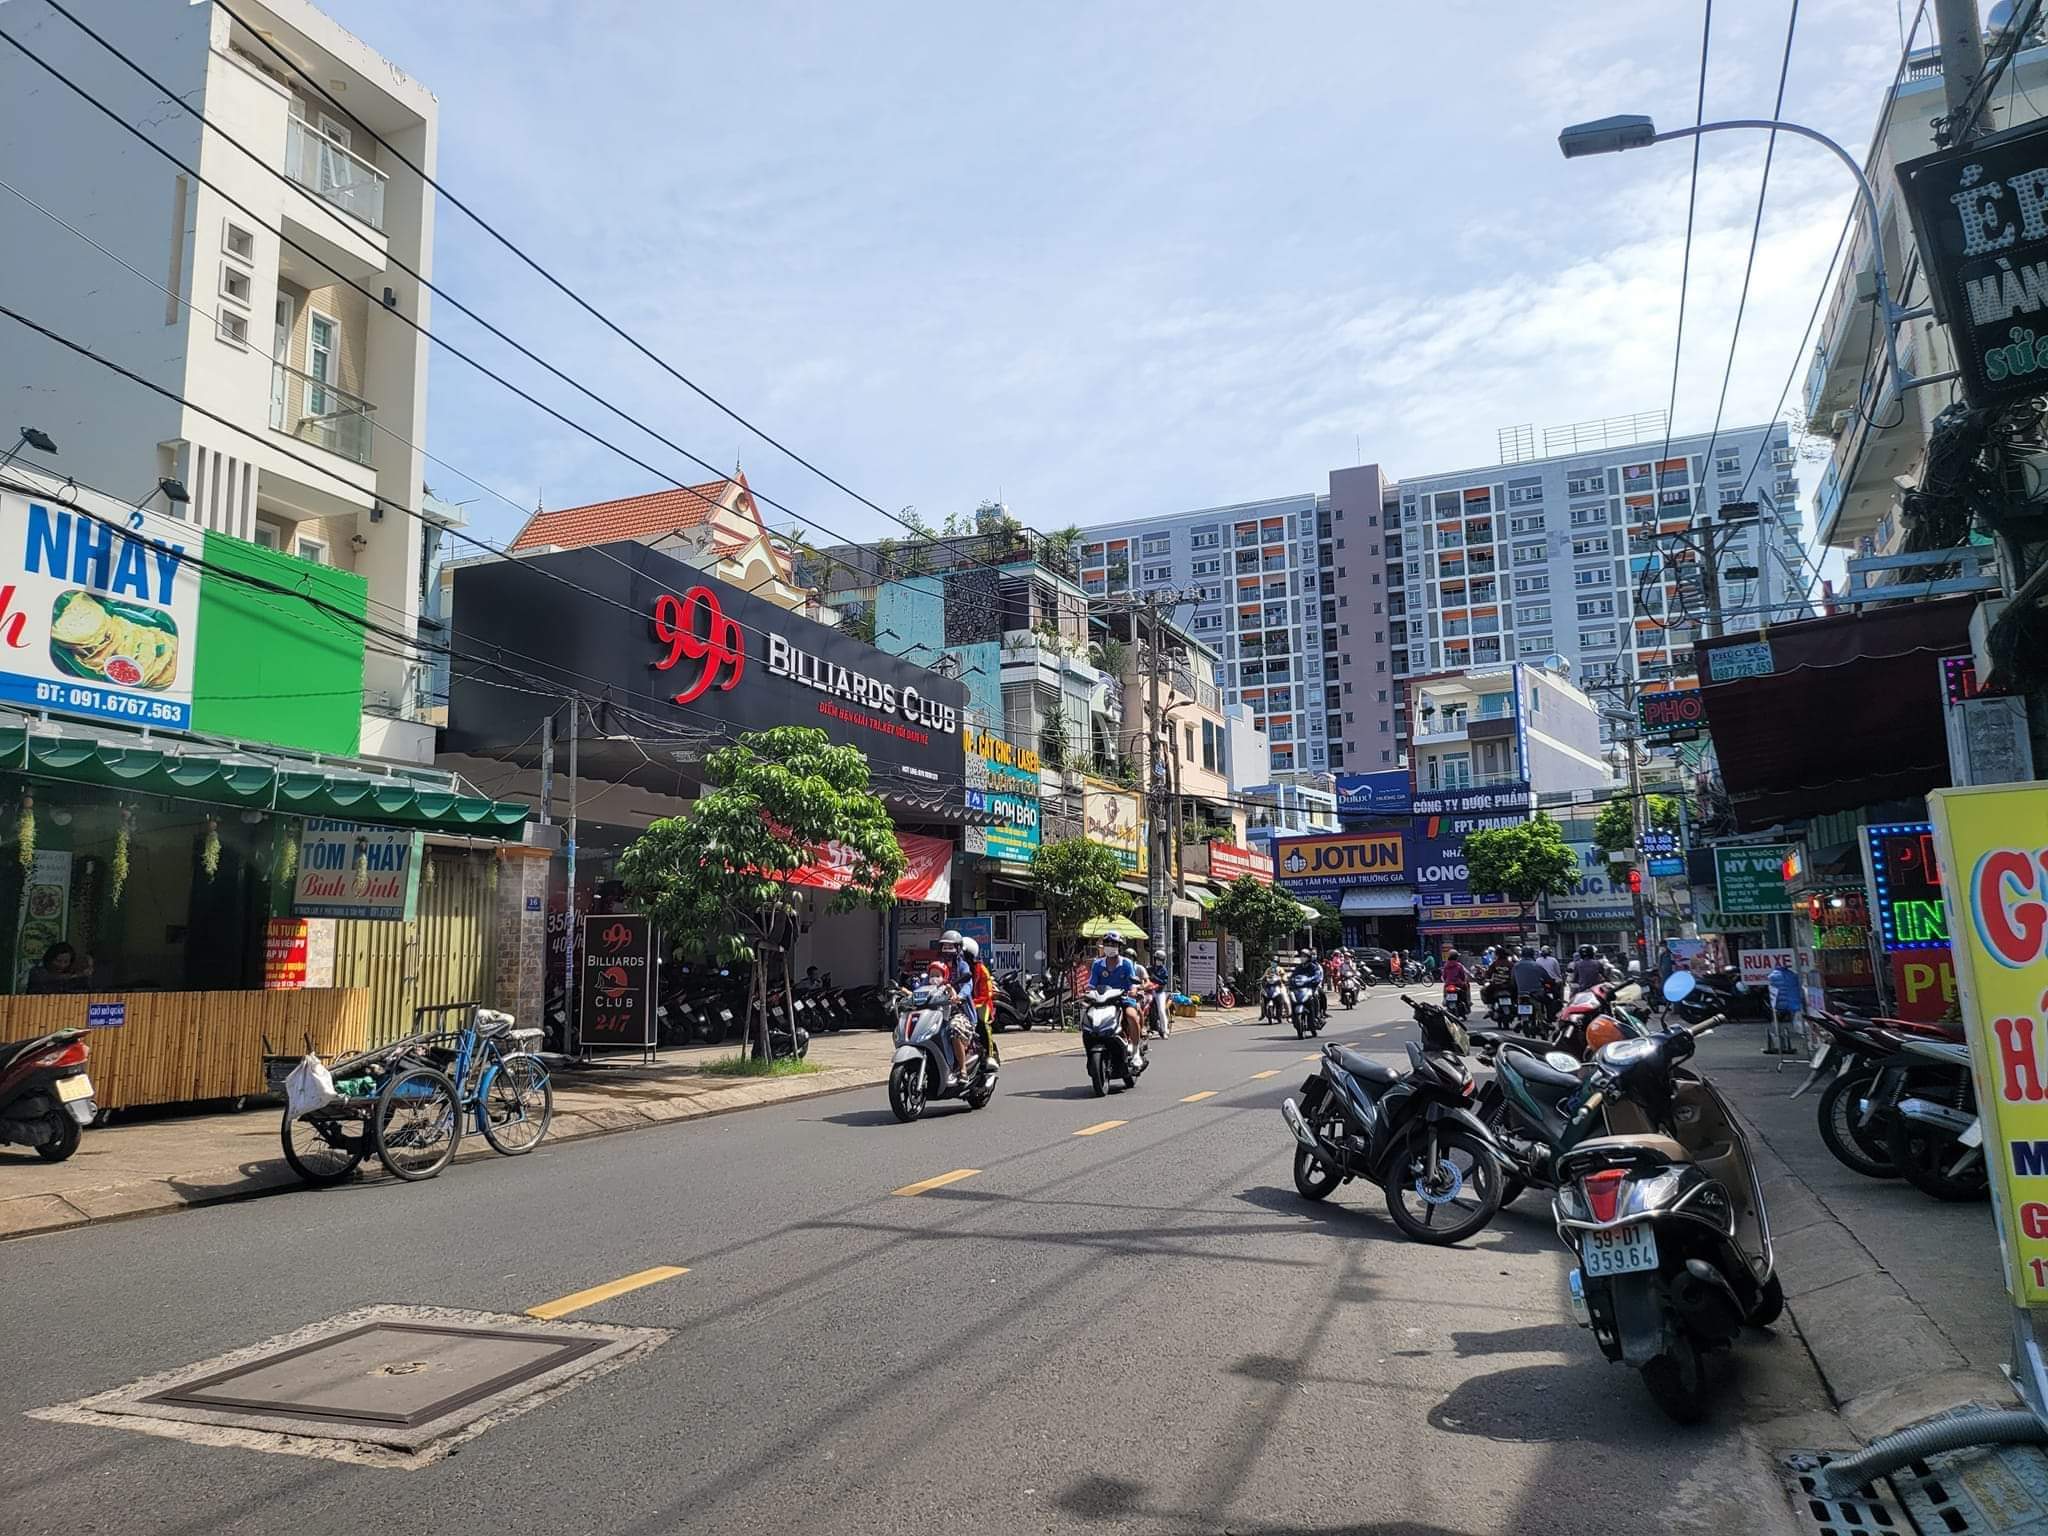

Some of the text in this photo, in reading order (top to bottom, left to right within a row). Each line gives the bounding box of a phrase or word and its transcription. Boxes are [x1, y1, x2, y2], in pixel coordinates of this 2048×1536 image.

[25, 503, 185, 606] NHẢY
[655, 585, 744, 704] 999
[768, 631, 956, 734] BILLIARDS CLUB
[37, 682, 182, 722] ĐT: 091.6767.563
[1413, 788, 1529, 813] CÔNG TY DƯỢC PHẨM
[1455, 819, 1474, 832] FPT
[303, 837, 346, 870] TÔM
[1312, 842, 1398, 871] JOTUN
[1724, 859, 1748, 873] HY
[1390, 873, 1404, 882] GIA
[1417, 865, 1470, 882] LONG
[1554, 909, 1578, 919] 370
[1972, 848, 2048, 967] G
[602, 923, 632, 952] 999
[588, 954, 645, 967] BILLIARDS
[996, 944, 1021, 969] THUỐC
[1773, 954, 1793, 968] XE
[595, 996, 633, 1009] CLUB
[1590, 1246, 1654, 1272] 359.64
